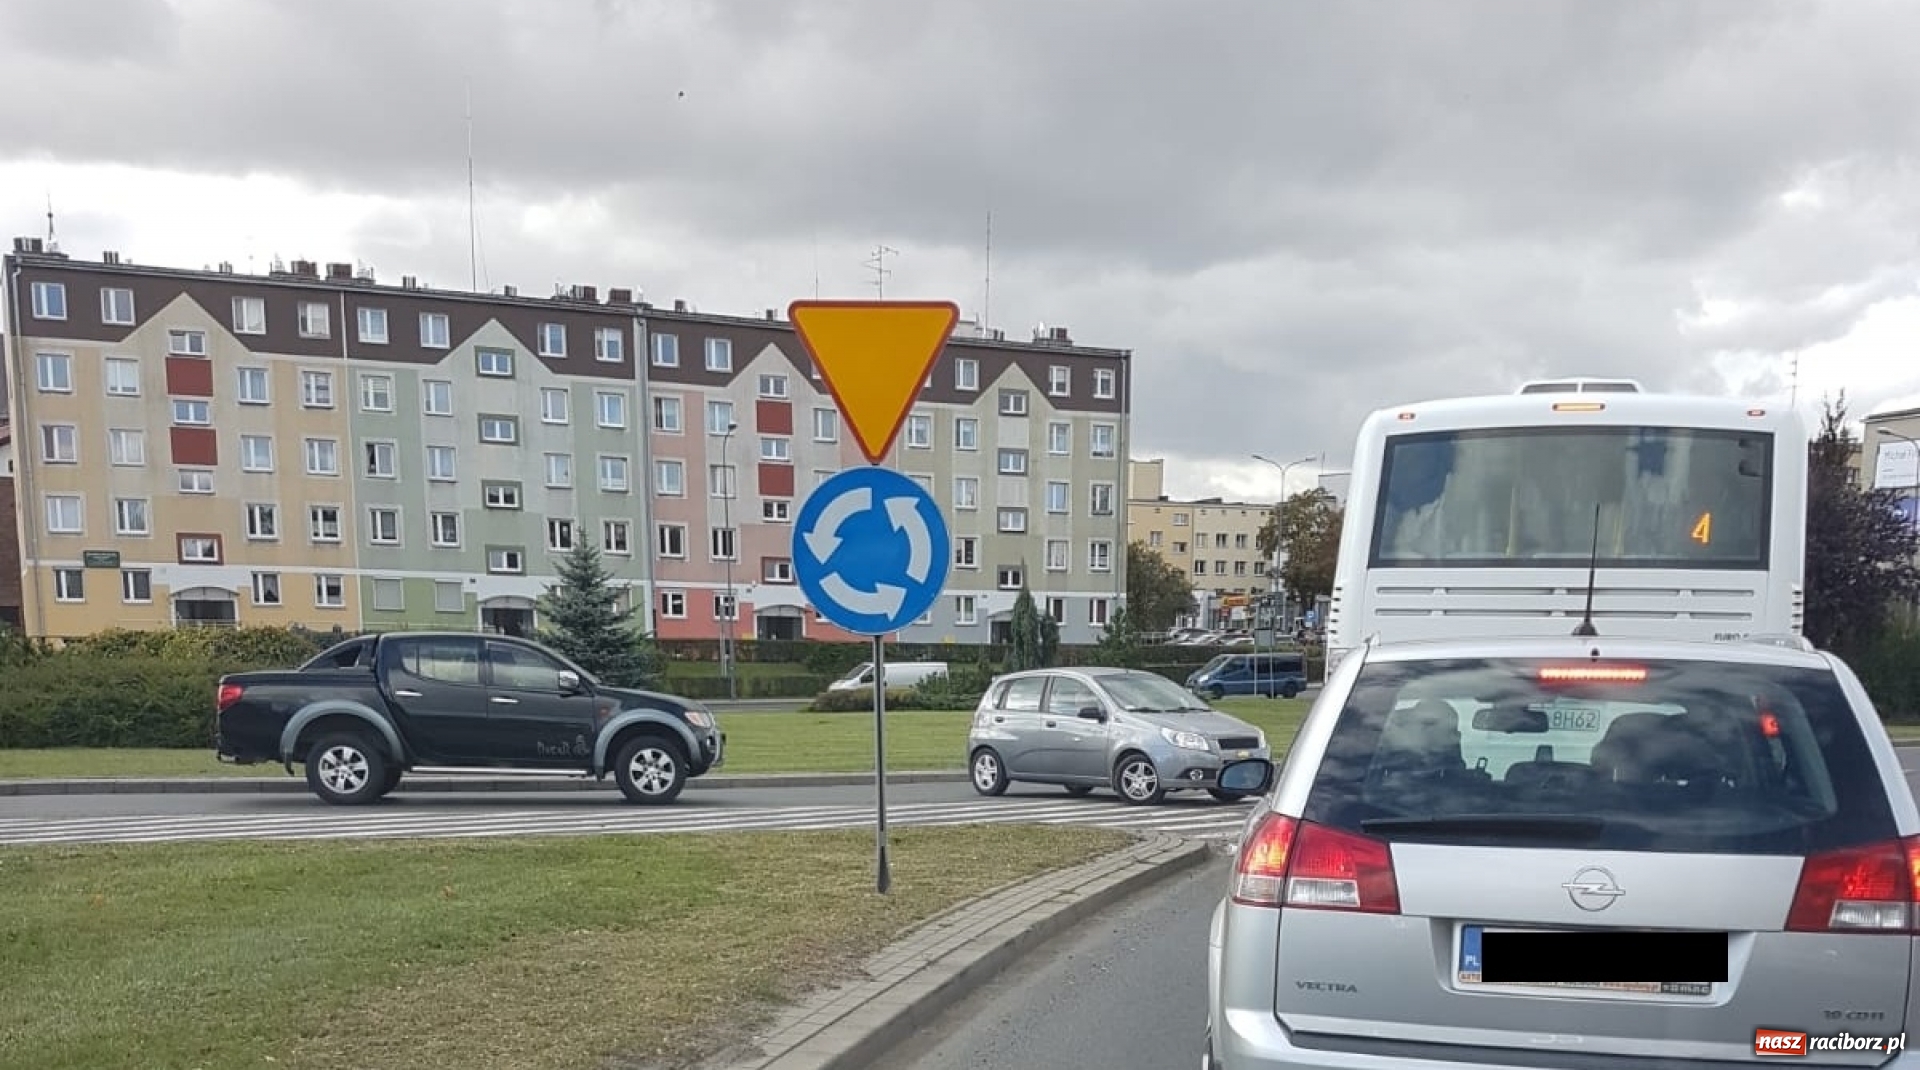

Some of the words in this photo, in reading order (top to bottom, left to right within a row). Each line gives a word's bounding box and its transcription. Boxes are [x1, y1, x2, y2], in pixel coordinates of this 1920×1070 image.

[1692, 512, 1710, 543] 4
[1464, 954, 1480, 967] PL
[1295, 981, 1358, 993] VECTRA
